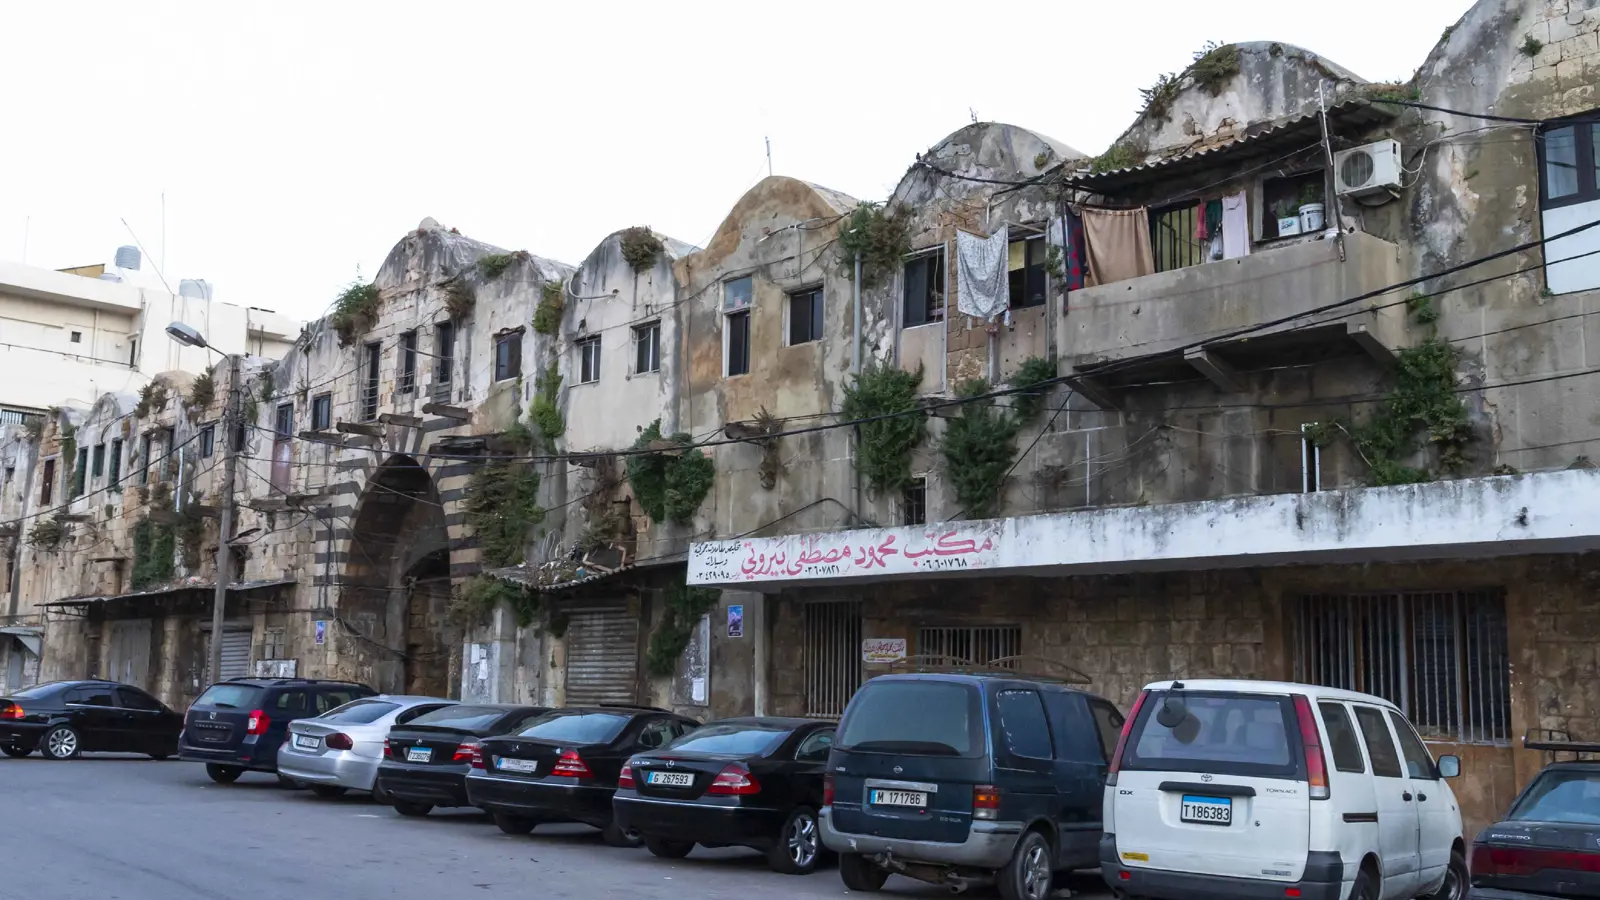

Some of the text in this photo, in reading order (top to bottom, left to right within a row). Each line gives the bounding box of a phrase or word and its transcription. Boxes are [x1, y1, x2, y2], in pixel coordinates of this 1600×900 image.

[855, 534, 898, 569] محمود
[904, 531, 993, 567] مكتب
[654, 773, 689, 785] G 267593
[877, 792, 921, 805] M 171786
[1184, 804, 1230, 821] T186383
